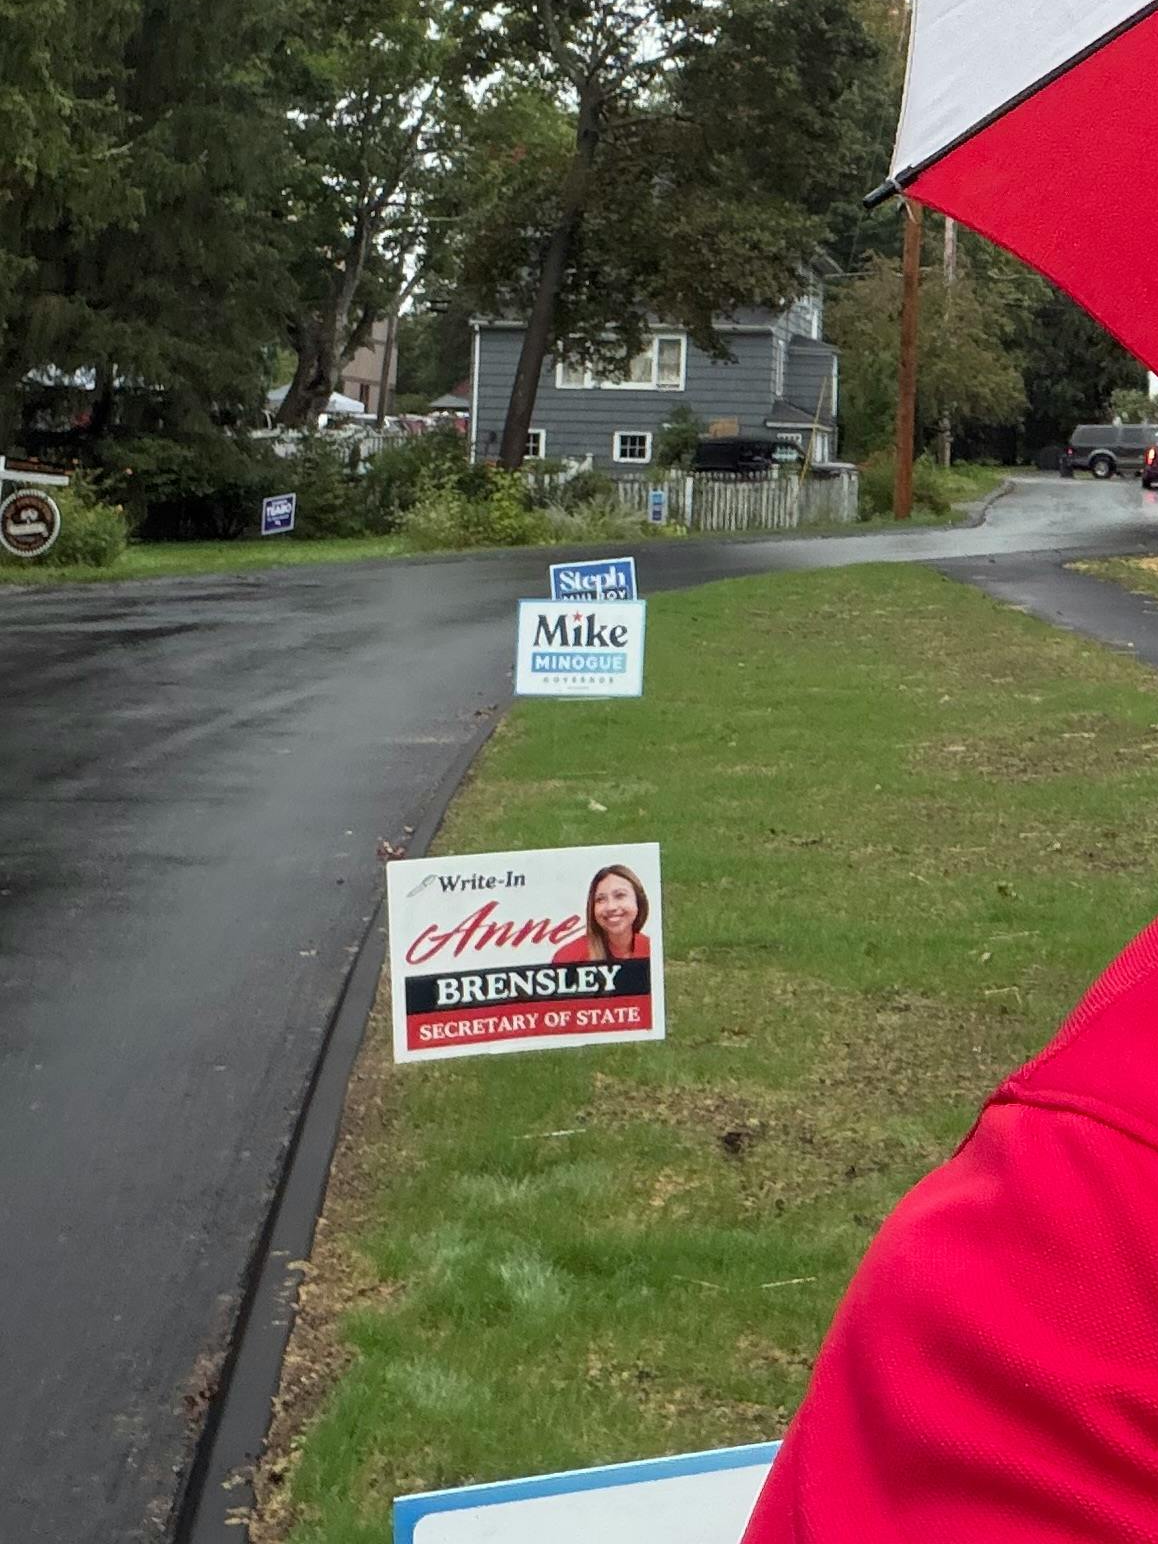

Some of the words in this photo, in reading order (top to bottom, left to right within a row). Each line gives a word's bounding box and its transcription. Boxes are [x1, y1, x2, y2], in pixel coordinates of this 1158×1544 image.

[559, 565, 626, 599] Steph
[533, 610, 628, 648] Mike
[535, 656, 623, 670] MINOGUE
[438, 870, 526, 893] Write-In
[405, 900, 585, 965] Anne
[436, 964, 622, 1005] BRENSLEY
[419, 1013, 538, 1041] SECRETARY
[544, 1010, 570, 1027] OF
[576, 1007, 641, 1025] STATE
